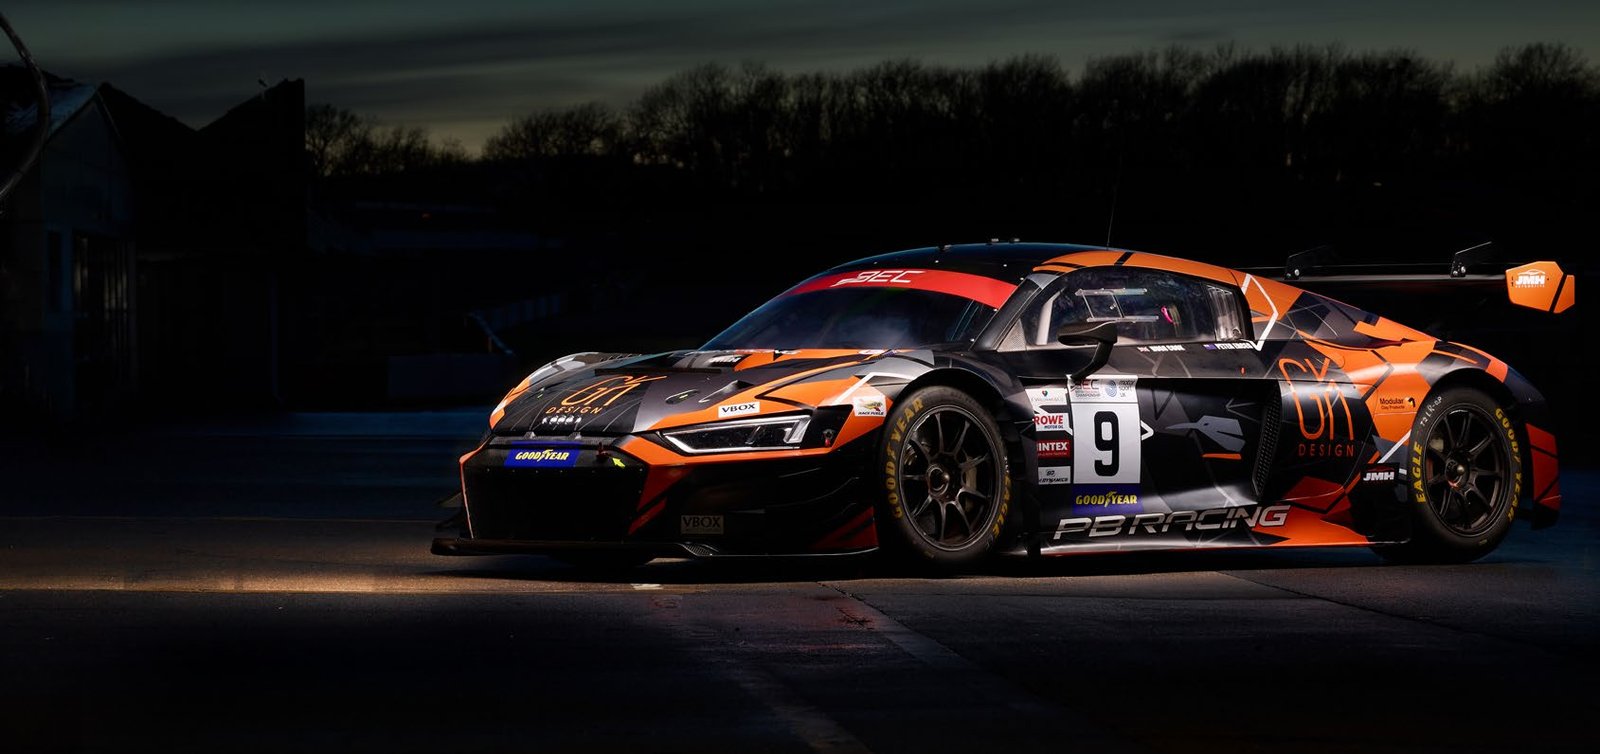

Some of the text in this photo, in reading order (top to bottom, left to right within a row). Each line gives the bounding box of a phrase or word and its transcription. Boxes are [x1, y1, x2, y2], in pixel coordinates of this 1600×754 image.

[1516, 275, 1546, 285] JMH
[1379, 397, 1403, 405] Modular
[546, 406, 603, 415] DESIGN
[721, 402, 756, 414] VBOX
[1033, 415, 1064, 425] ROWE
[1094, 411, 1119, 476] 9
[515, 448, 570, 462] GOODYEAR
[1297, 443, 1355, 458] DESIGN
[1362, 470, 1395, 482] JMH
[1411, 440, 1427, 504] EAGLE
[1075, 490, 1138, 508] GOODYEAR
[682, 516, 721, 528] VBOX
[1053, 504, 1292, 541] PB RACING
